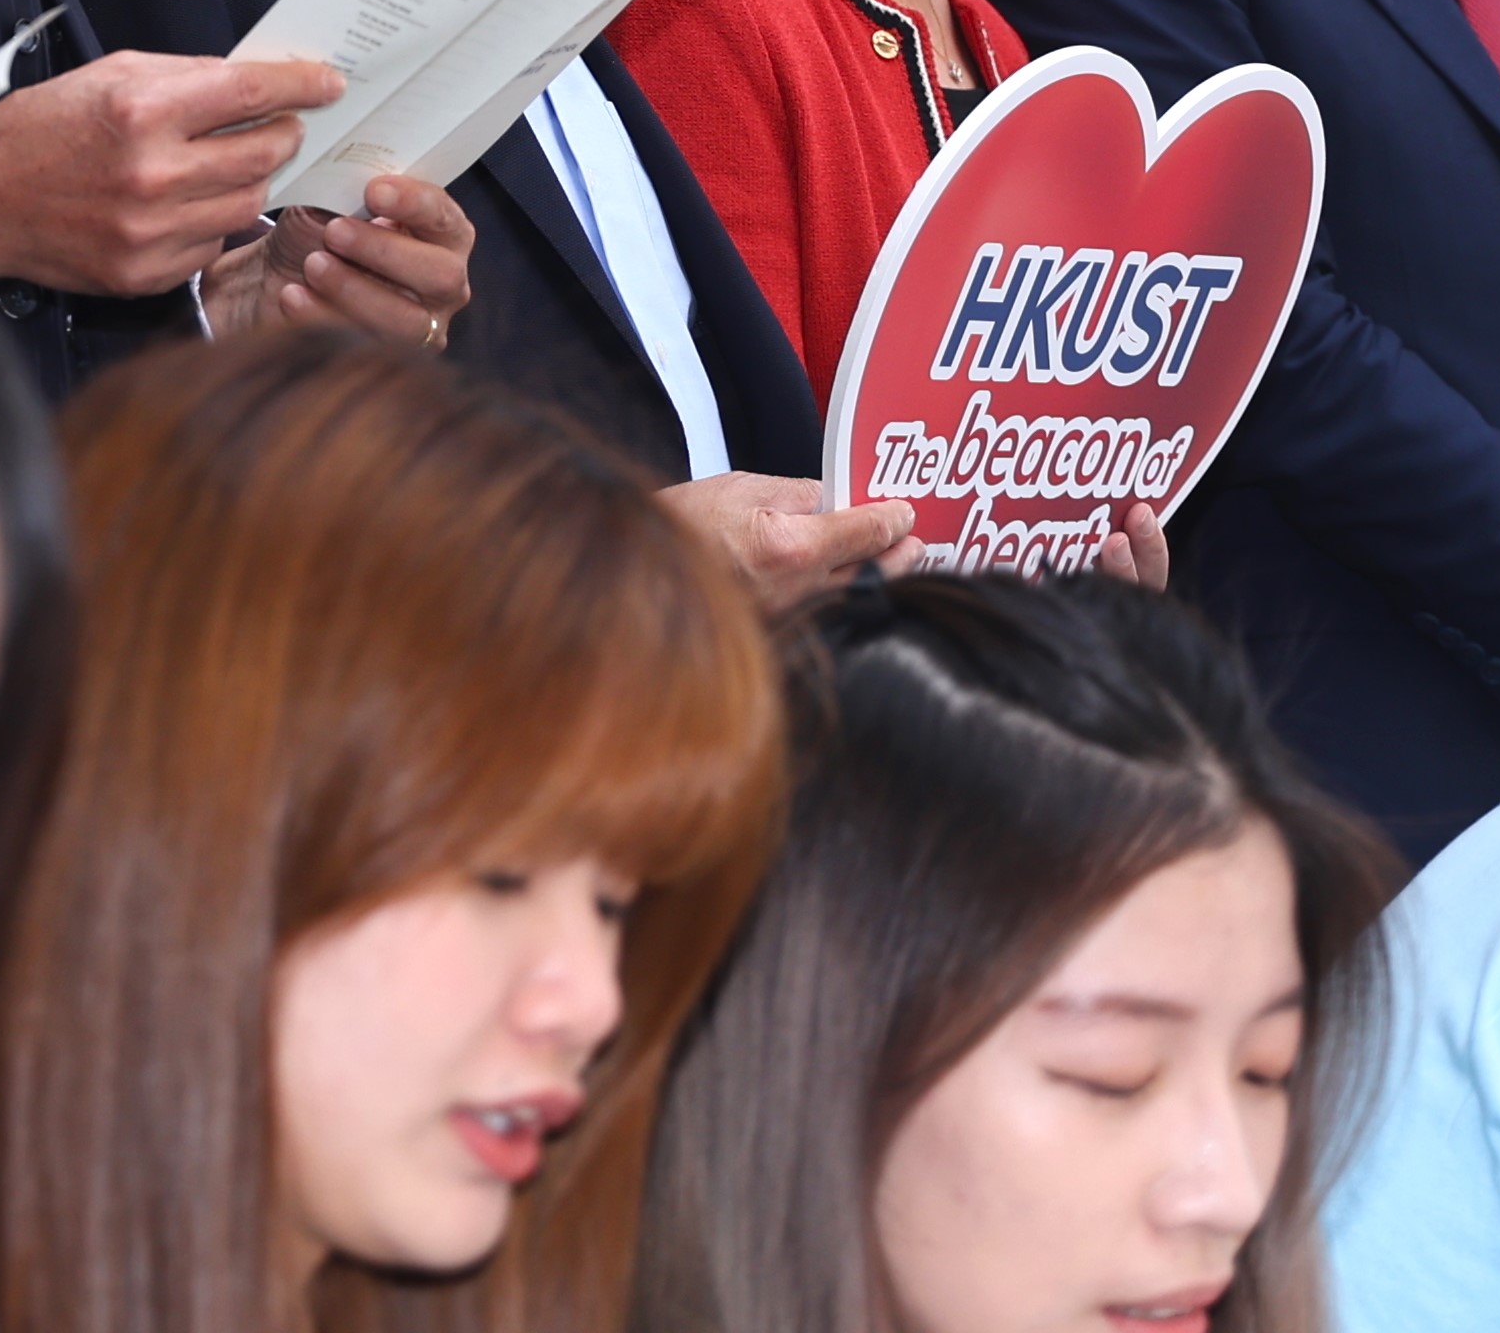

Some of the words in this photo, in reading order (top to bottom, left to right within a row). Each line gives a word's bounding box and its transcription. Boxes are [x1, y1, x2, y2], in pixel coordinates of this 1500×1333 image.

[938, 254, 1235, 376] HKUST
[876, 433, 940, 485] The
[944, 403, 1143, 487] beacon
[1142, 437, 1185, 486] of
